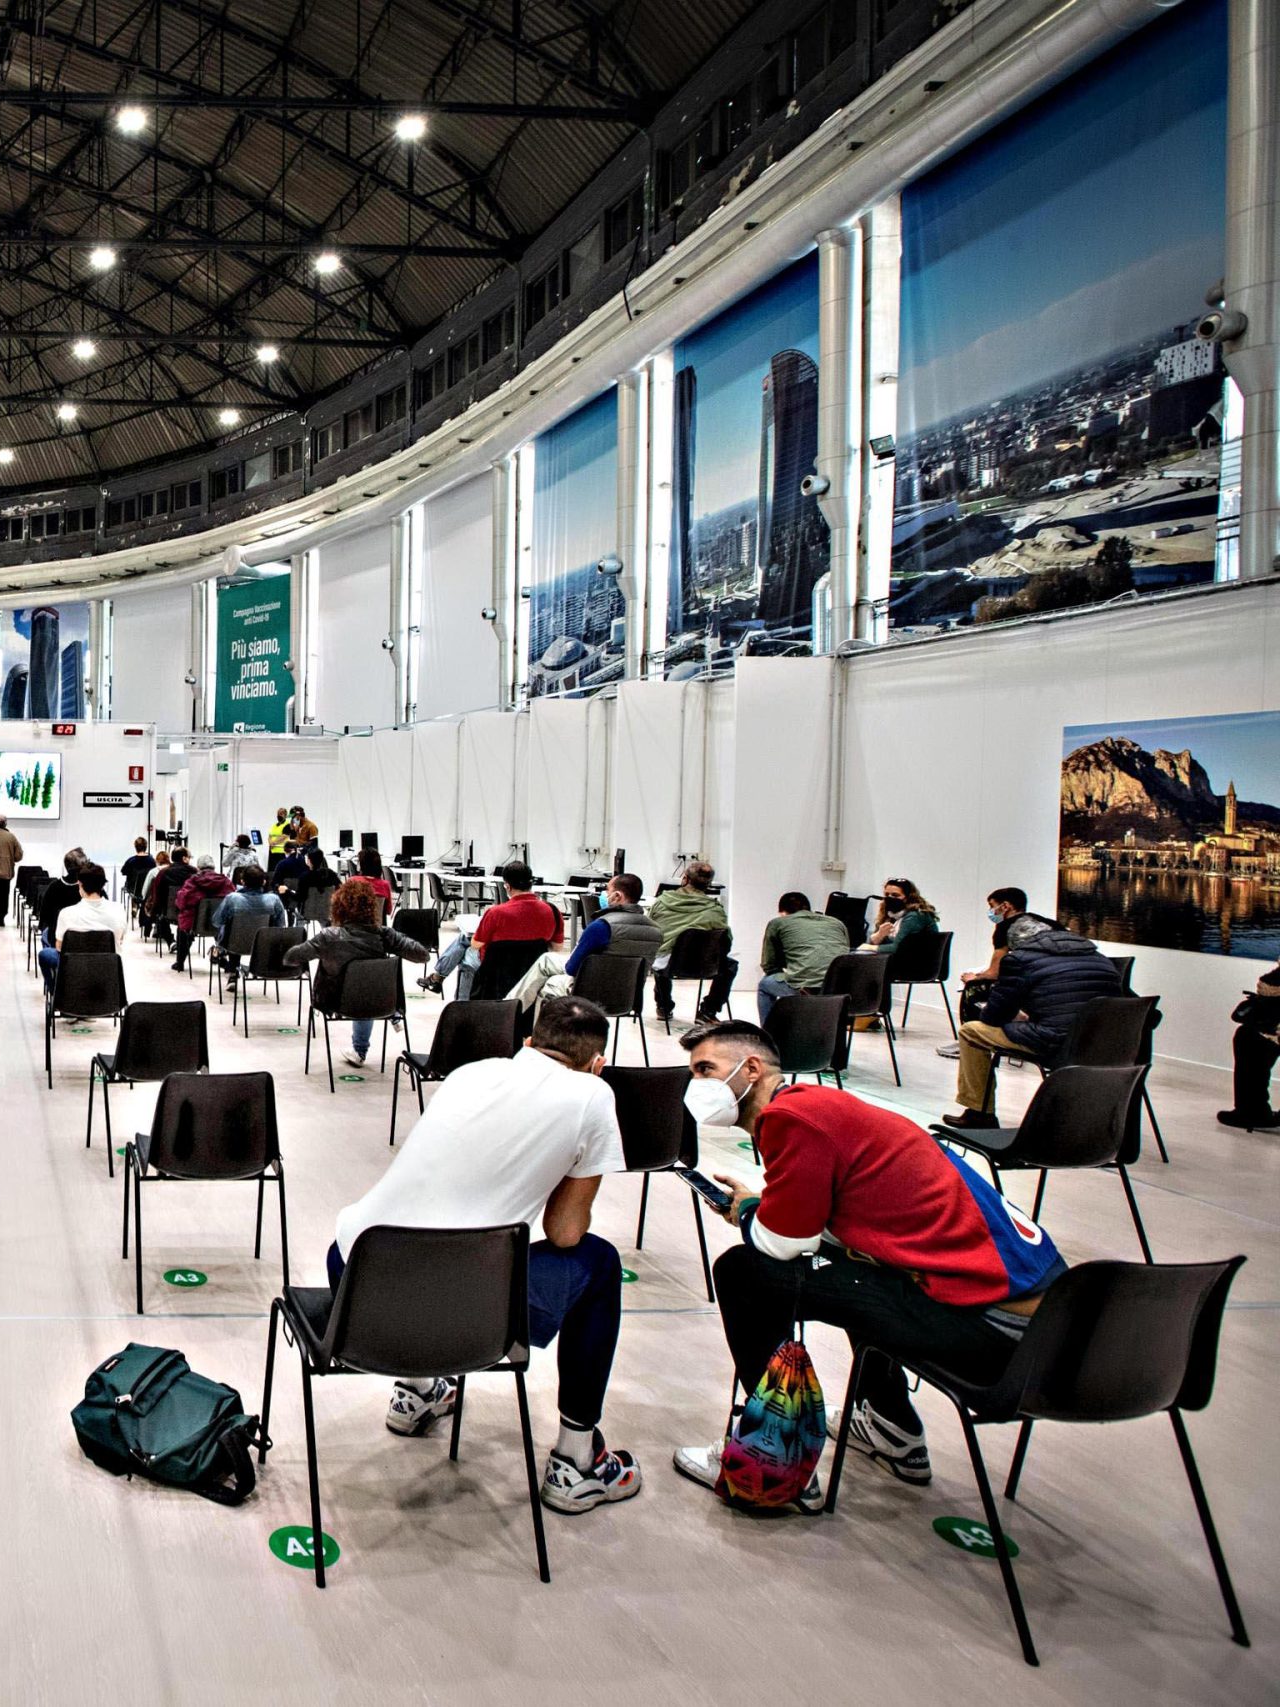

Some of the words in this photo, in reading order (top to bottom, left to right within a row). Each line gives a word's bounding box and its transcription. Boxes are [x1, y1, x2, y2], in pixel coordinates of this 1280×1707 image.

[231, 639, 246, 660] Più
[248, 637, 281, 656] siamo,
[240, 658, 269, 683] prima
[231, 678, 278, 700] vinciamo.
[173, 1273, 199, 1283] A3
